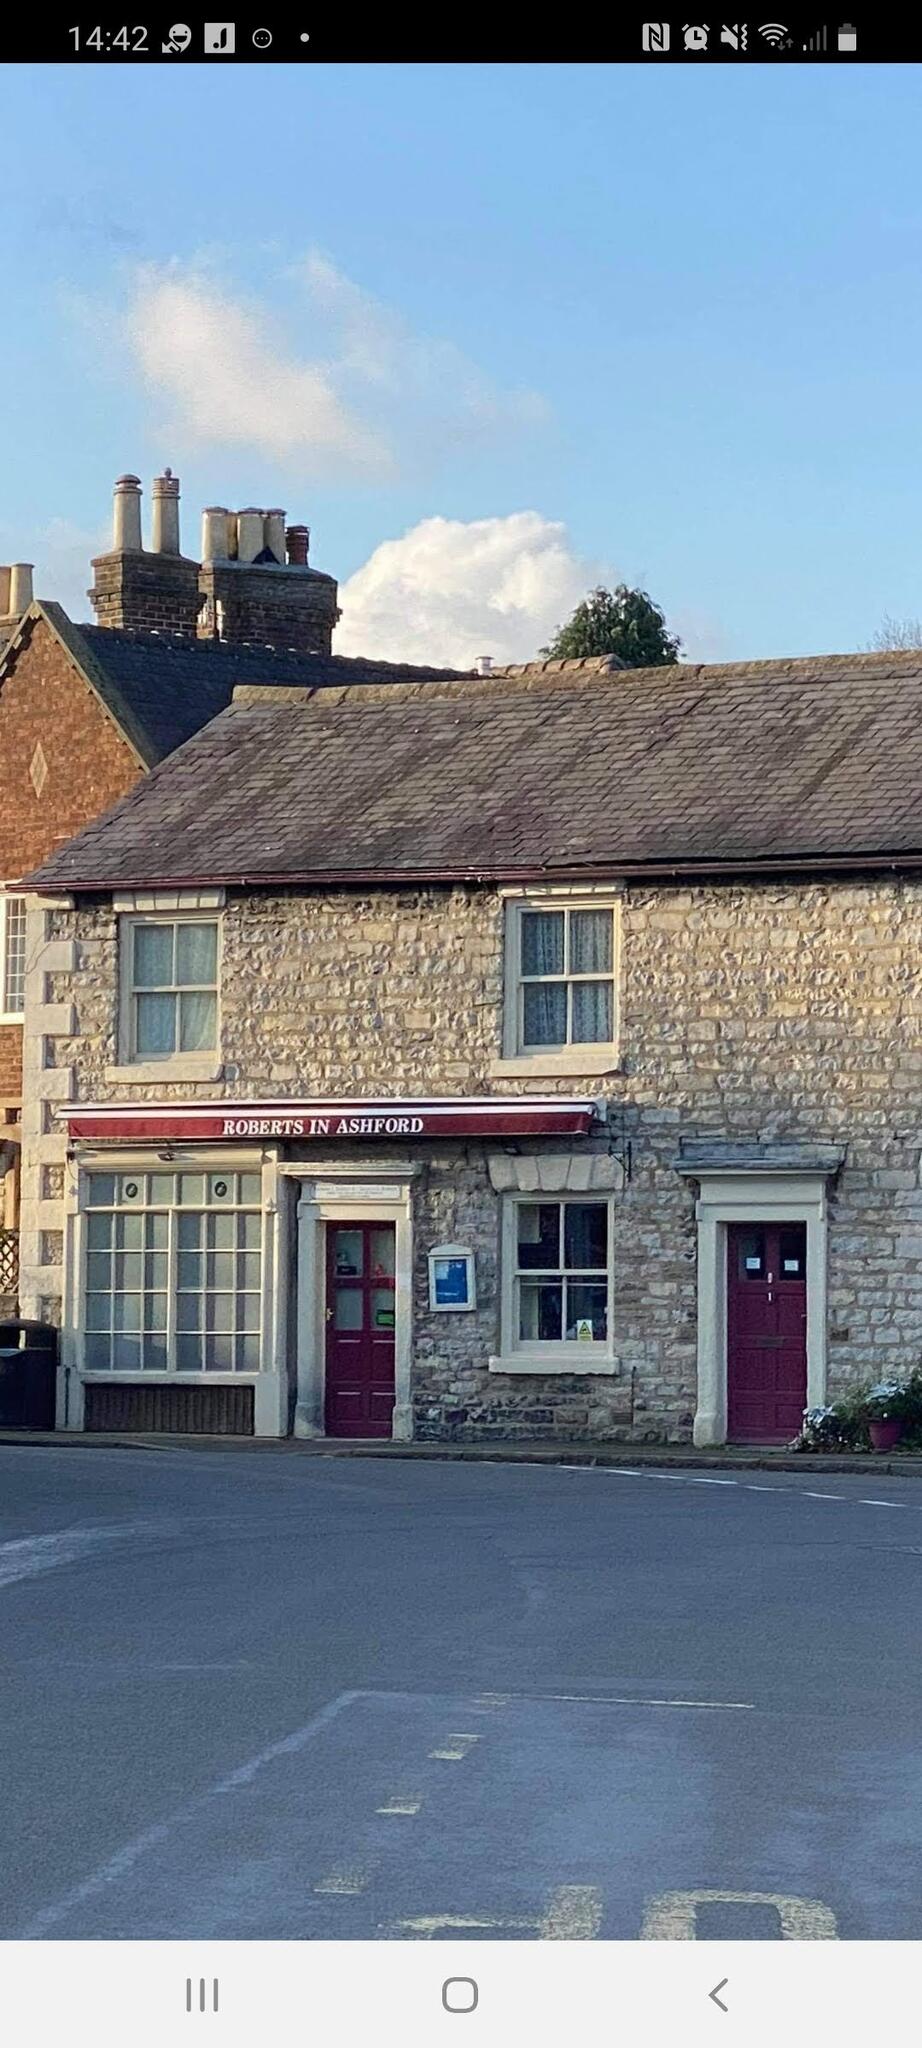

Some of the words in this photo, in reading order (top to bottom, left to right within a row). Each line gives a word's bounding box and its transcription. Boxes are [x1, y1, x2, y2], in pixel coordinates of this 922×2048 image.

[222, 1119, 304, 1136] ROBERTS
[308, 1118, 331, 1135] IN
[335, 1117, 424, 1135] ASHFORD
